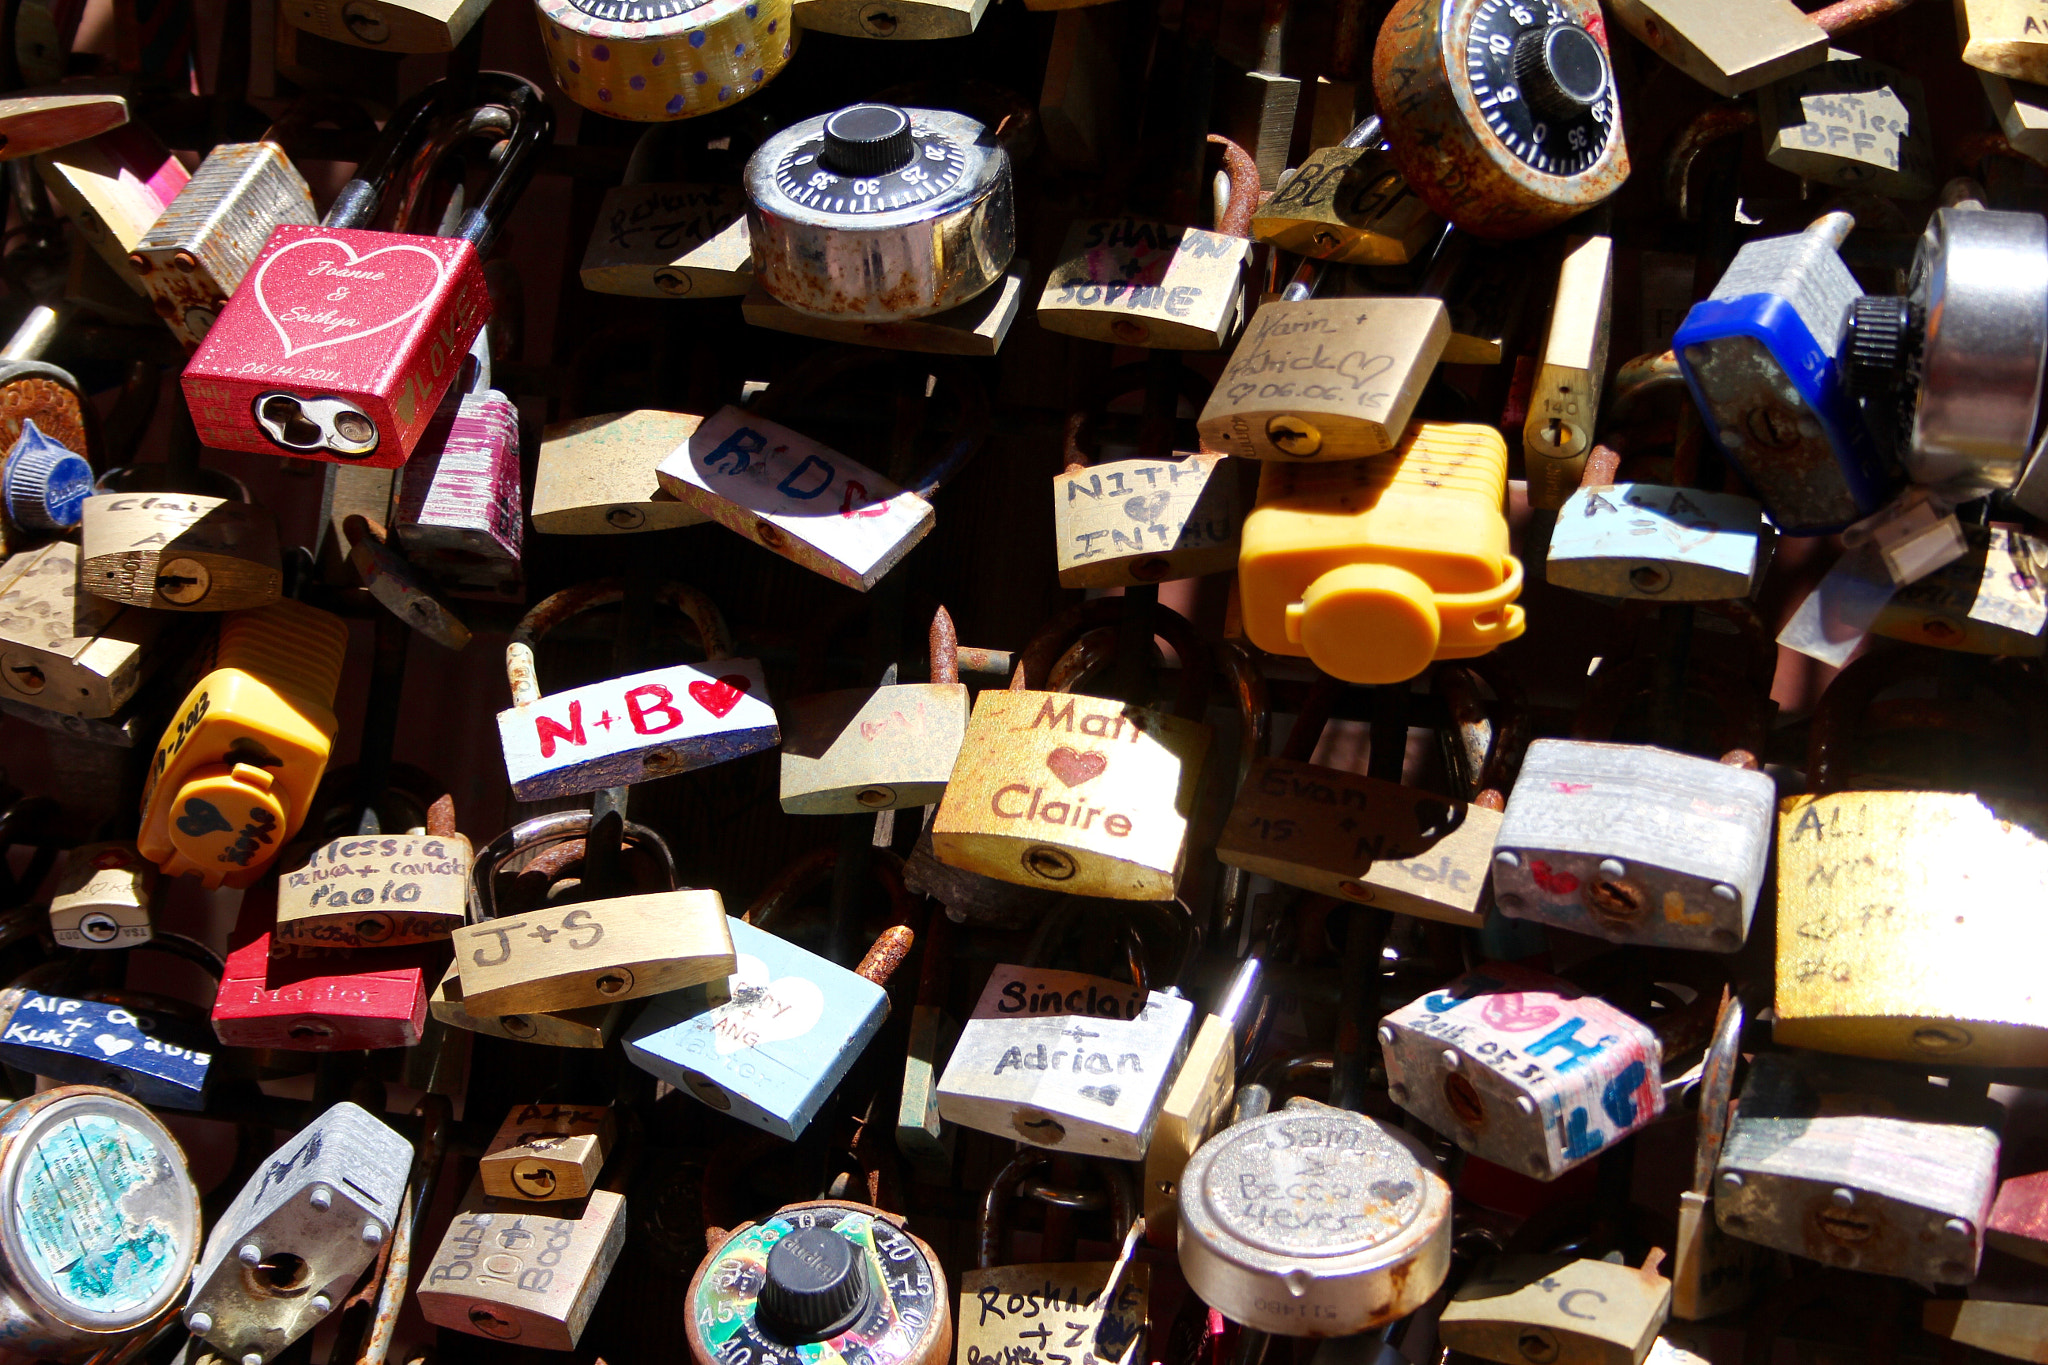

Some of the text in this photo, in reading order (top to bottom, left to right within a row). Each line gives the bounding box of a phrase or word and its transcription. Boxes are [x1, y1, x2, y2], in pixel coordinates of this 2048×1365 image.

[1488, 33, 1512, 56] 10
[1496, 85, 1518, 104] 5
[1532, 121, 1548, 145] 0
[1800, 120, 1877, 156] BFF
[794, 154, 815, 167] 0
[924, 144, 946, 162] 20
[806, 172, 839, 191] 35
[853, 179, 881, 196] 30
[900, 166, 930, 186] 25
[1084, 216, 1236, 260] SHAWN
[307, 260, 386, 283] Joanne
[326, 285, 351, 301] &
[1056, 277, 1203, 317] SOPHIE
[279, 306, 361, 335] Sathya
[415, 284, 478, 402] LOVE
[1544, 398, 1578, 416] 140
[1583, 493, 1618, 518] A
[990, 783, 1133, 838] Claire
[122, 928, 149, 938] TSA
[22, 996, 83, 1016] Alf
[996, 980, 1163, 1022] Sinclair
[3, 1022, 79, 1049] Kuki
[992, 1043, 1145, 1077] Adrian
[1238, 1172, 1352, 1201] Becca
[876, 1230, 915, 1262] 10
[897, 1274, 934, 1298] 15
[699, 1300, 735, 1327] 45
[1557, 1287, 1609, 1322] C
